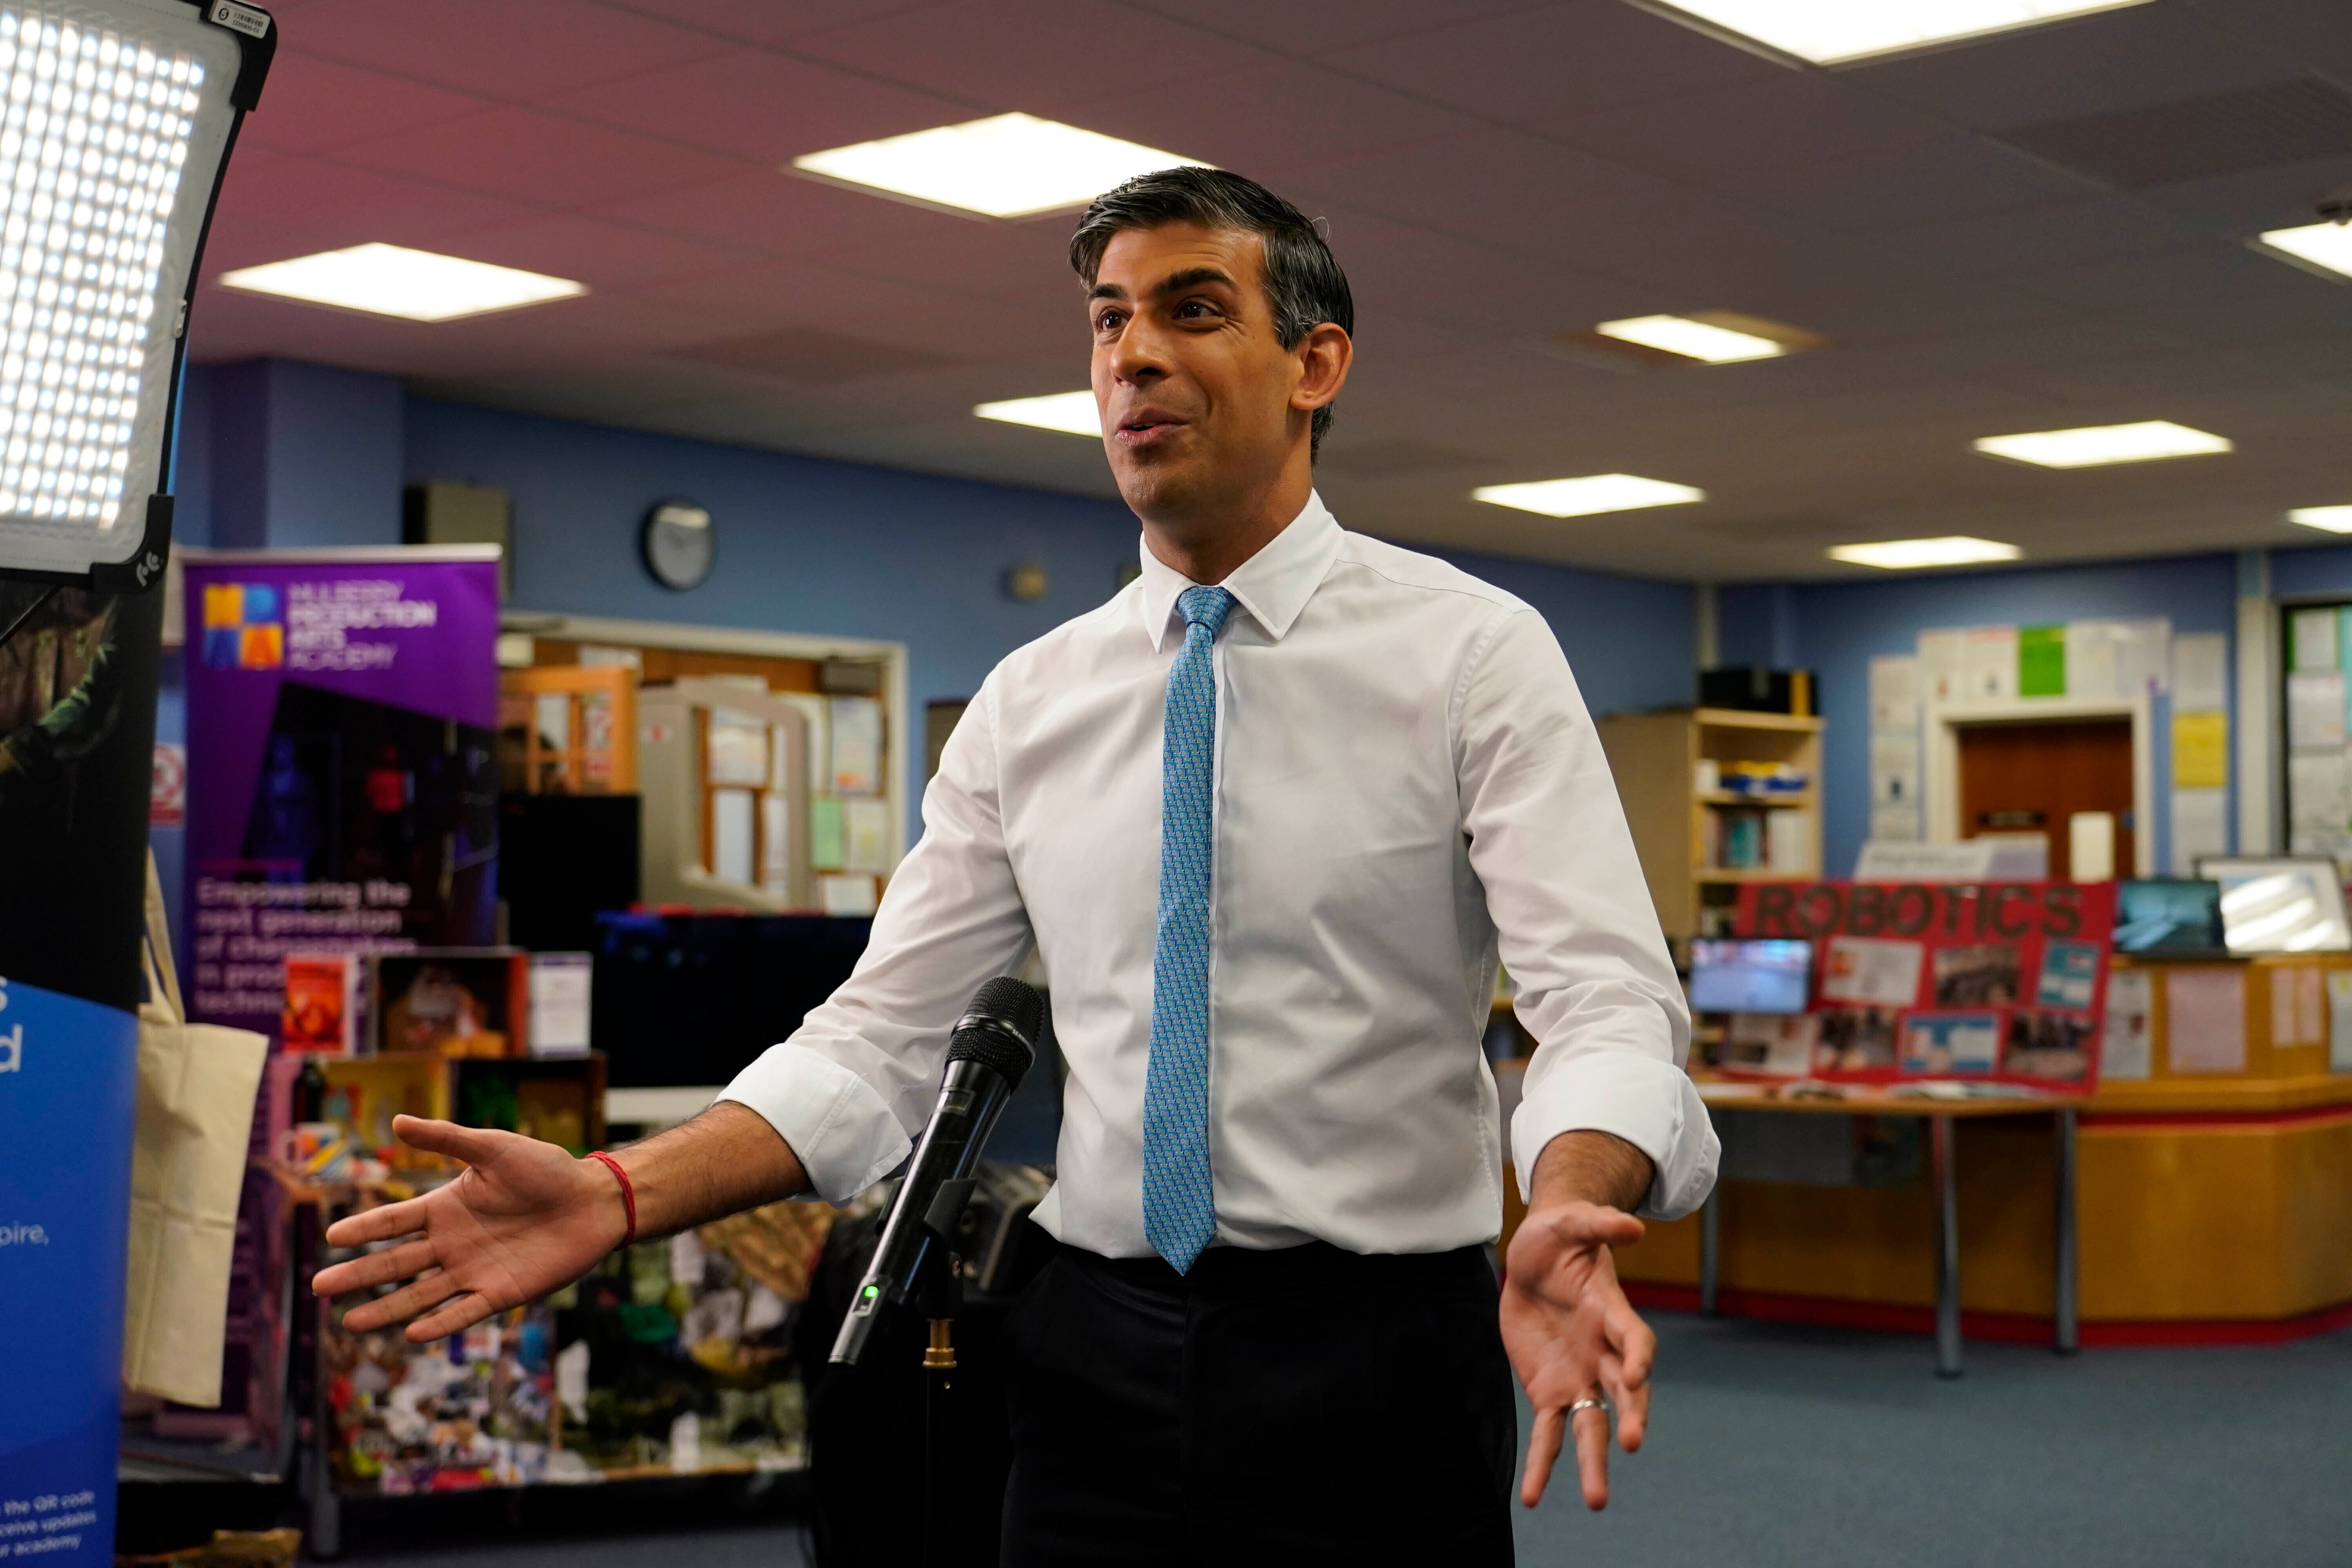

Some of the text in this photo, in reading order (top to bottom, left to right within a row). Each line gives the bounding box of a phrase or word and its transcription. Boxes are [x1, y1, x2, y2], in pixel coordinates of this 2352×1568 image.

[197, 877, 411, 909] Empowering the
[197, 909, 402, 939] next generation
[1754, 885, 2082, 937] ROBOTICS
[4, 1489, 95, 1516] the QR code
[40, 1510, 97, 1532] updates
[14, 1534, 81, 1555] academy
